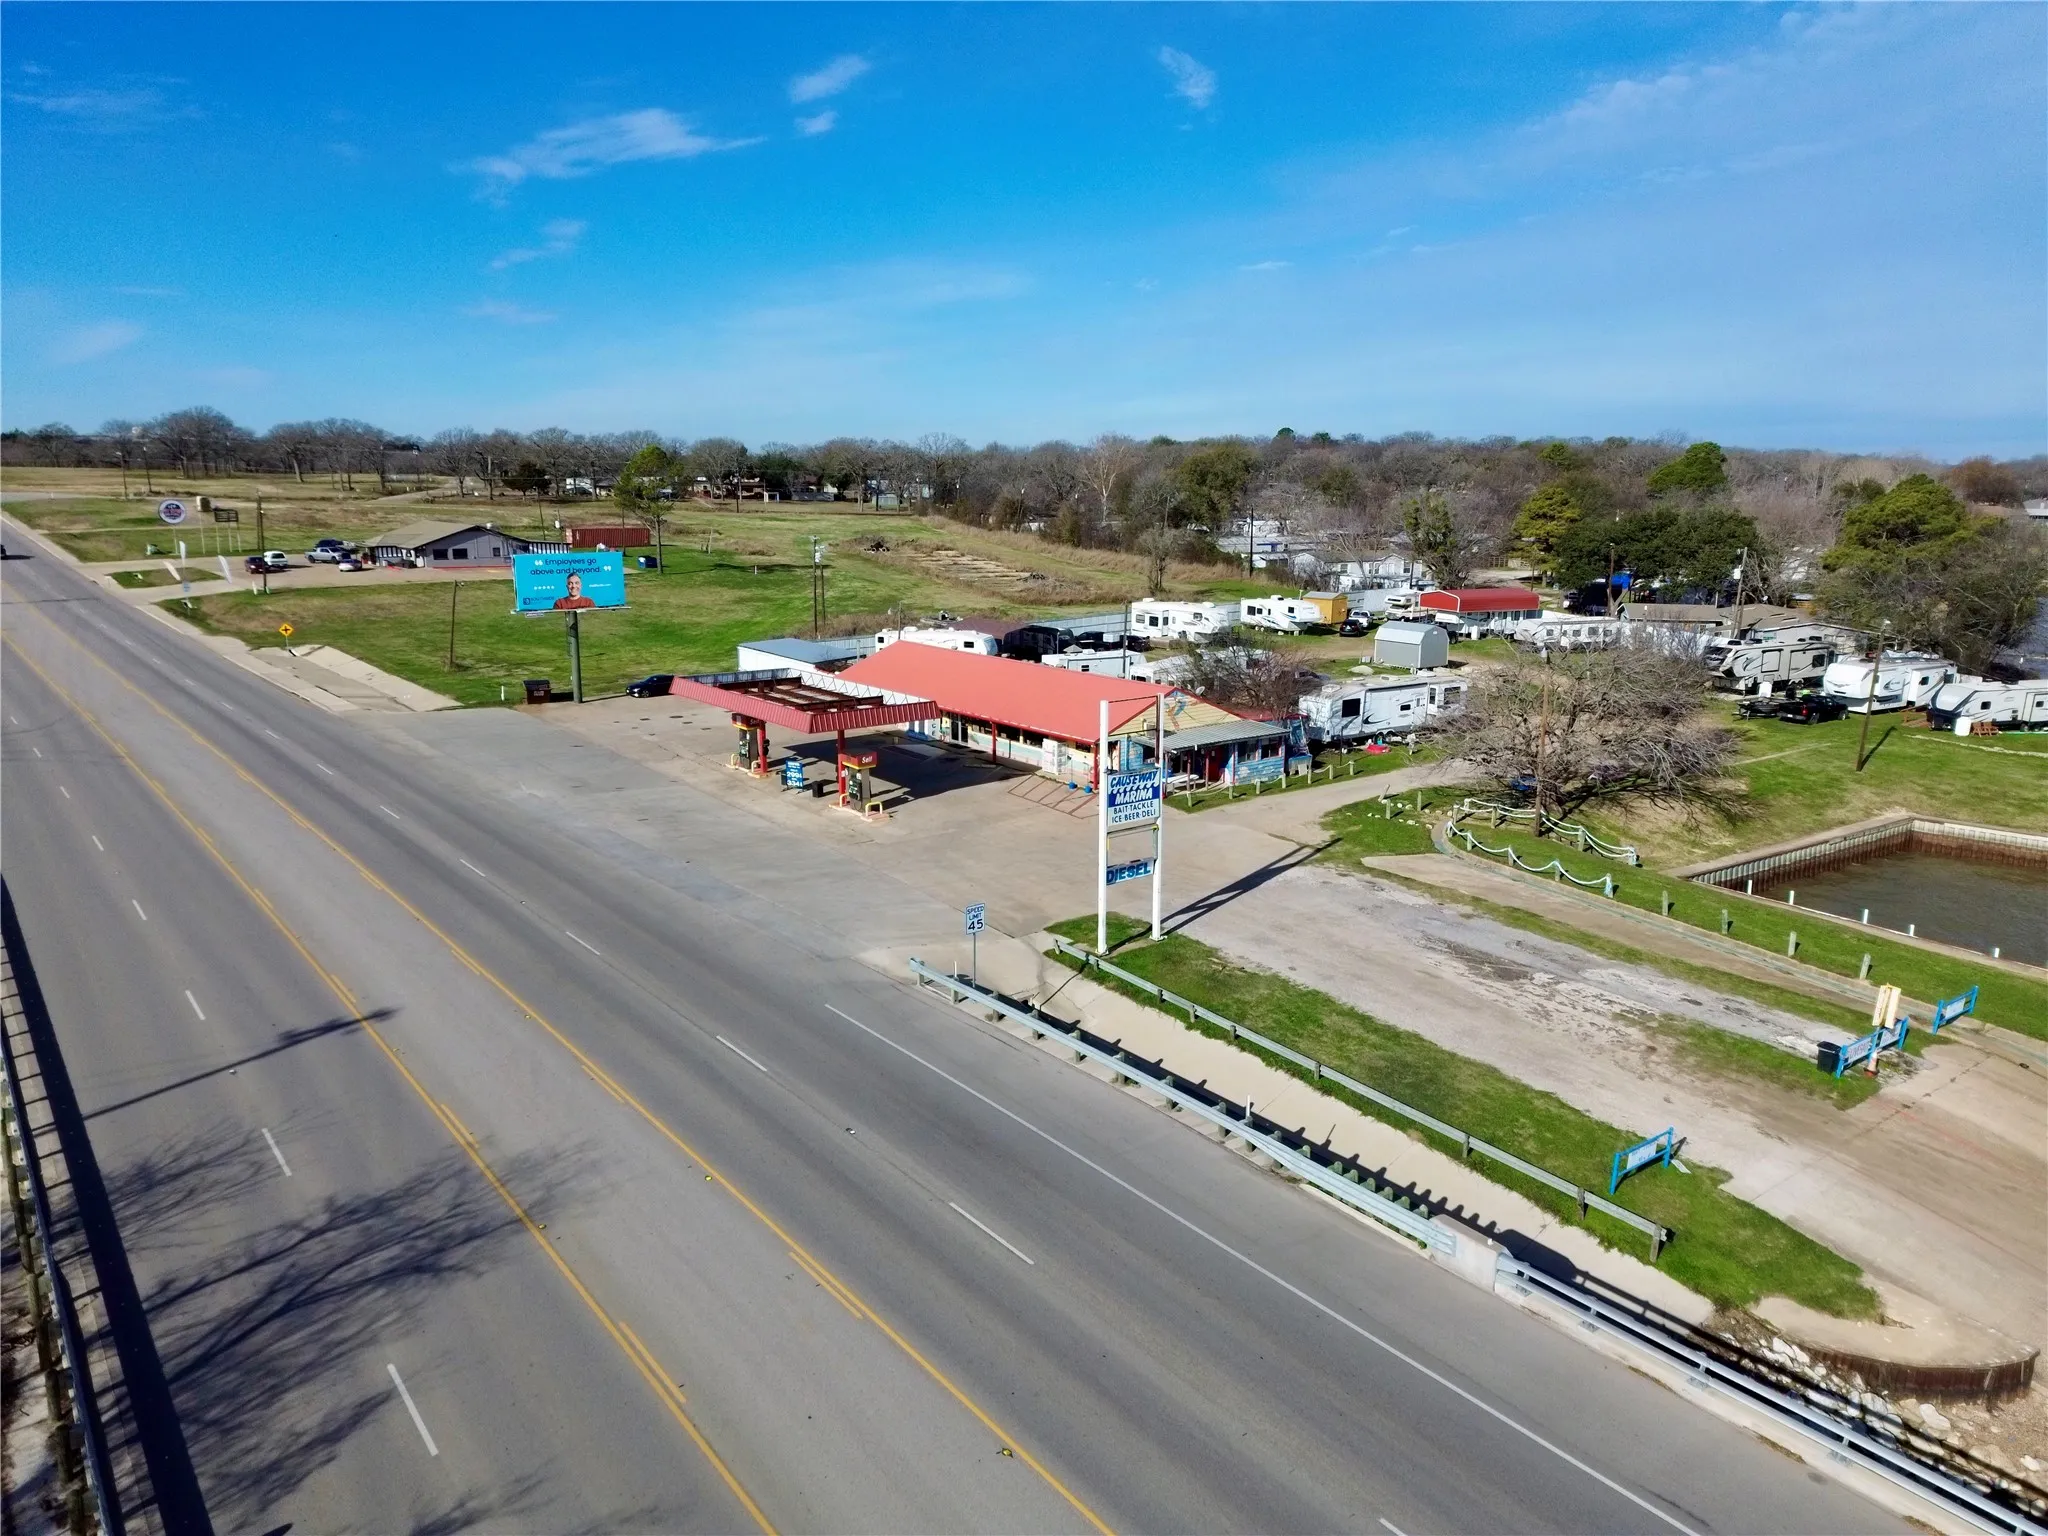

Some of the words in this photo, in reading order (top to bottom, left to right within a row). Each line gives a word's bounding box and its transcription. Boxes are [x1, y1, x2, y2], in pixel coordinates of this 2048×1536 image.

[545, 558, 586, 566] Employees
[1110, 771, 1158, 788] CAUSEWAY
[1114, 787, 1153, 805] MARINA
[1106, 862, 1151, 883] DIESEL
[967, 906, 984, 914] SPEED
[968, 919, 983, 930] 45
